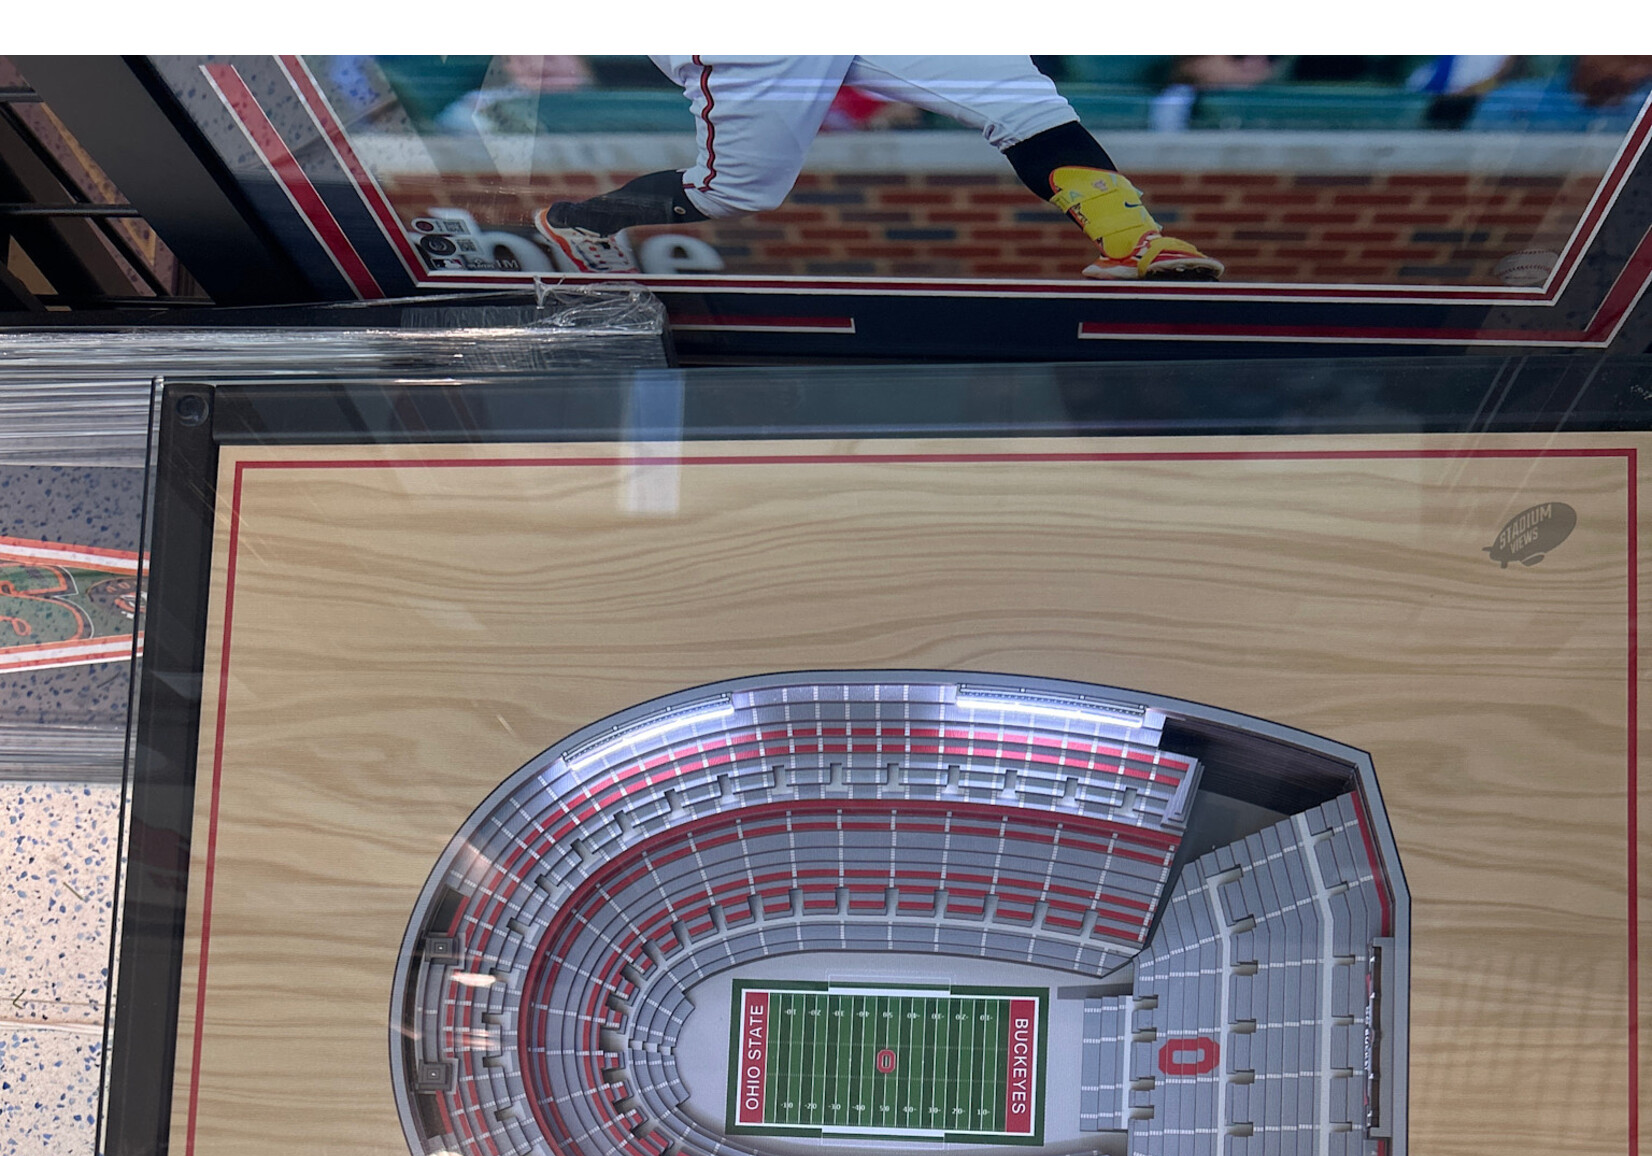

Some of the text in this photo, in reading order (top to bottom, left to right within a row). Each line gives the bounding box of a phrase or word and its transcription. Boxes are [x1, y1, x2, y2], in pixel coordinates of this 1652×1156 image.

[1500, 504, 1552, 550] STADIUM
[1510, 526, 1539, 554] VIEWS
[745, 1004, 764, 1110] OHIO STATE
[1012, 1017, 1029, 1114] BUCKEYES
